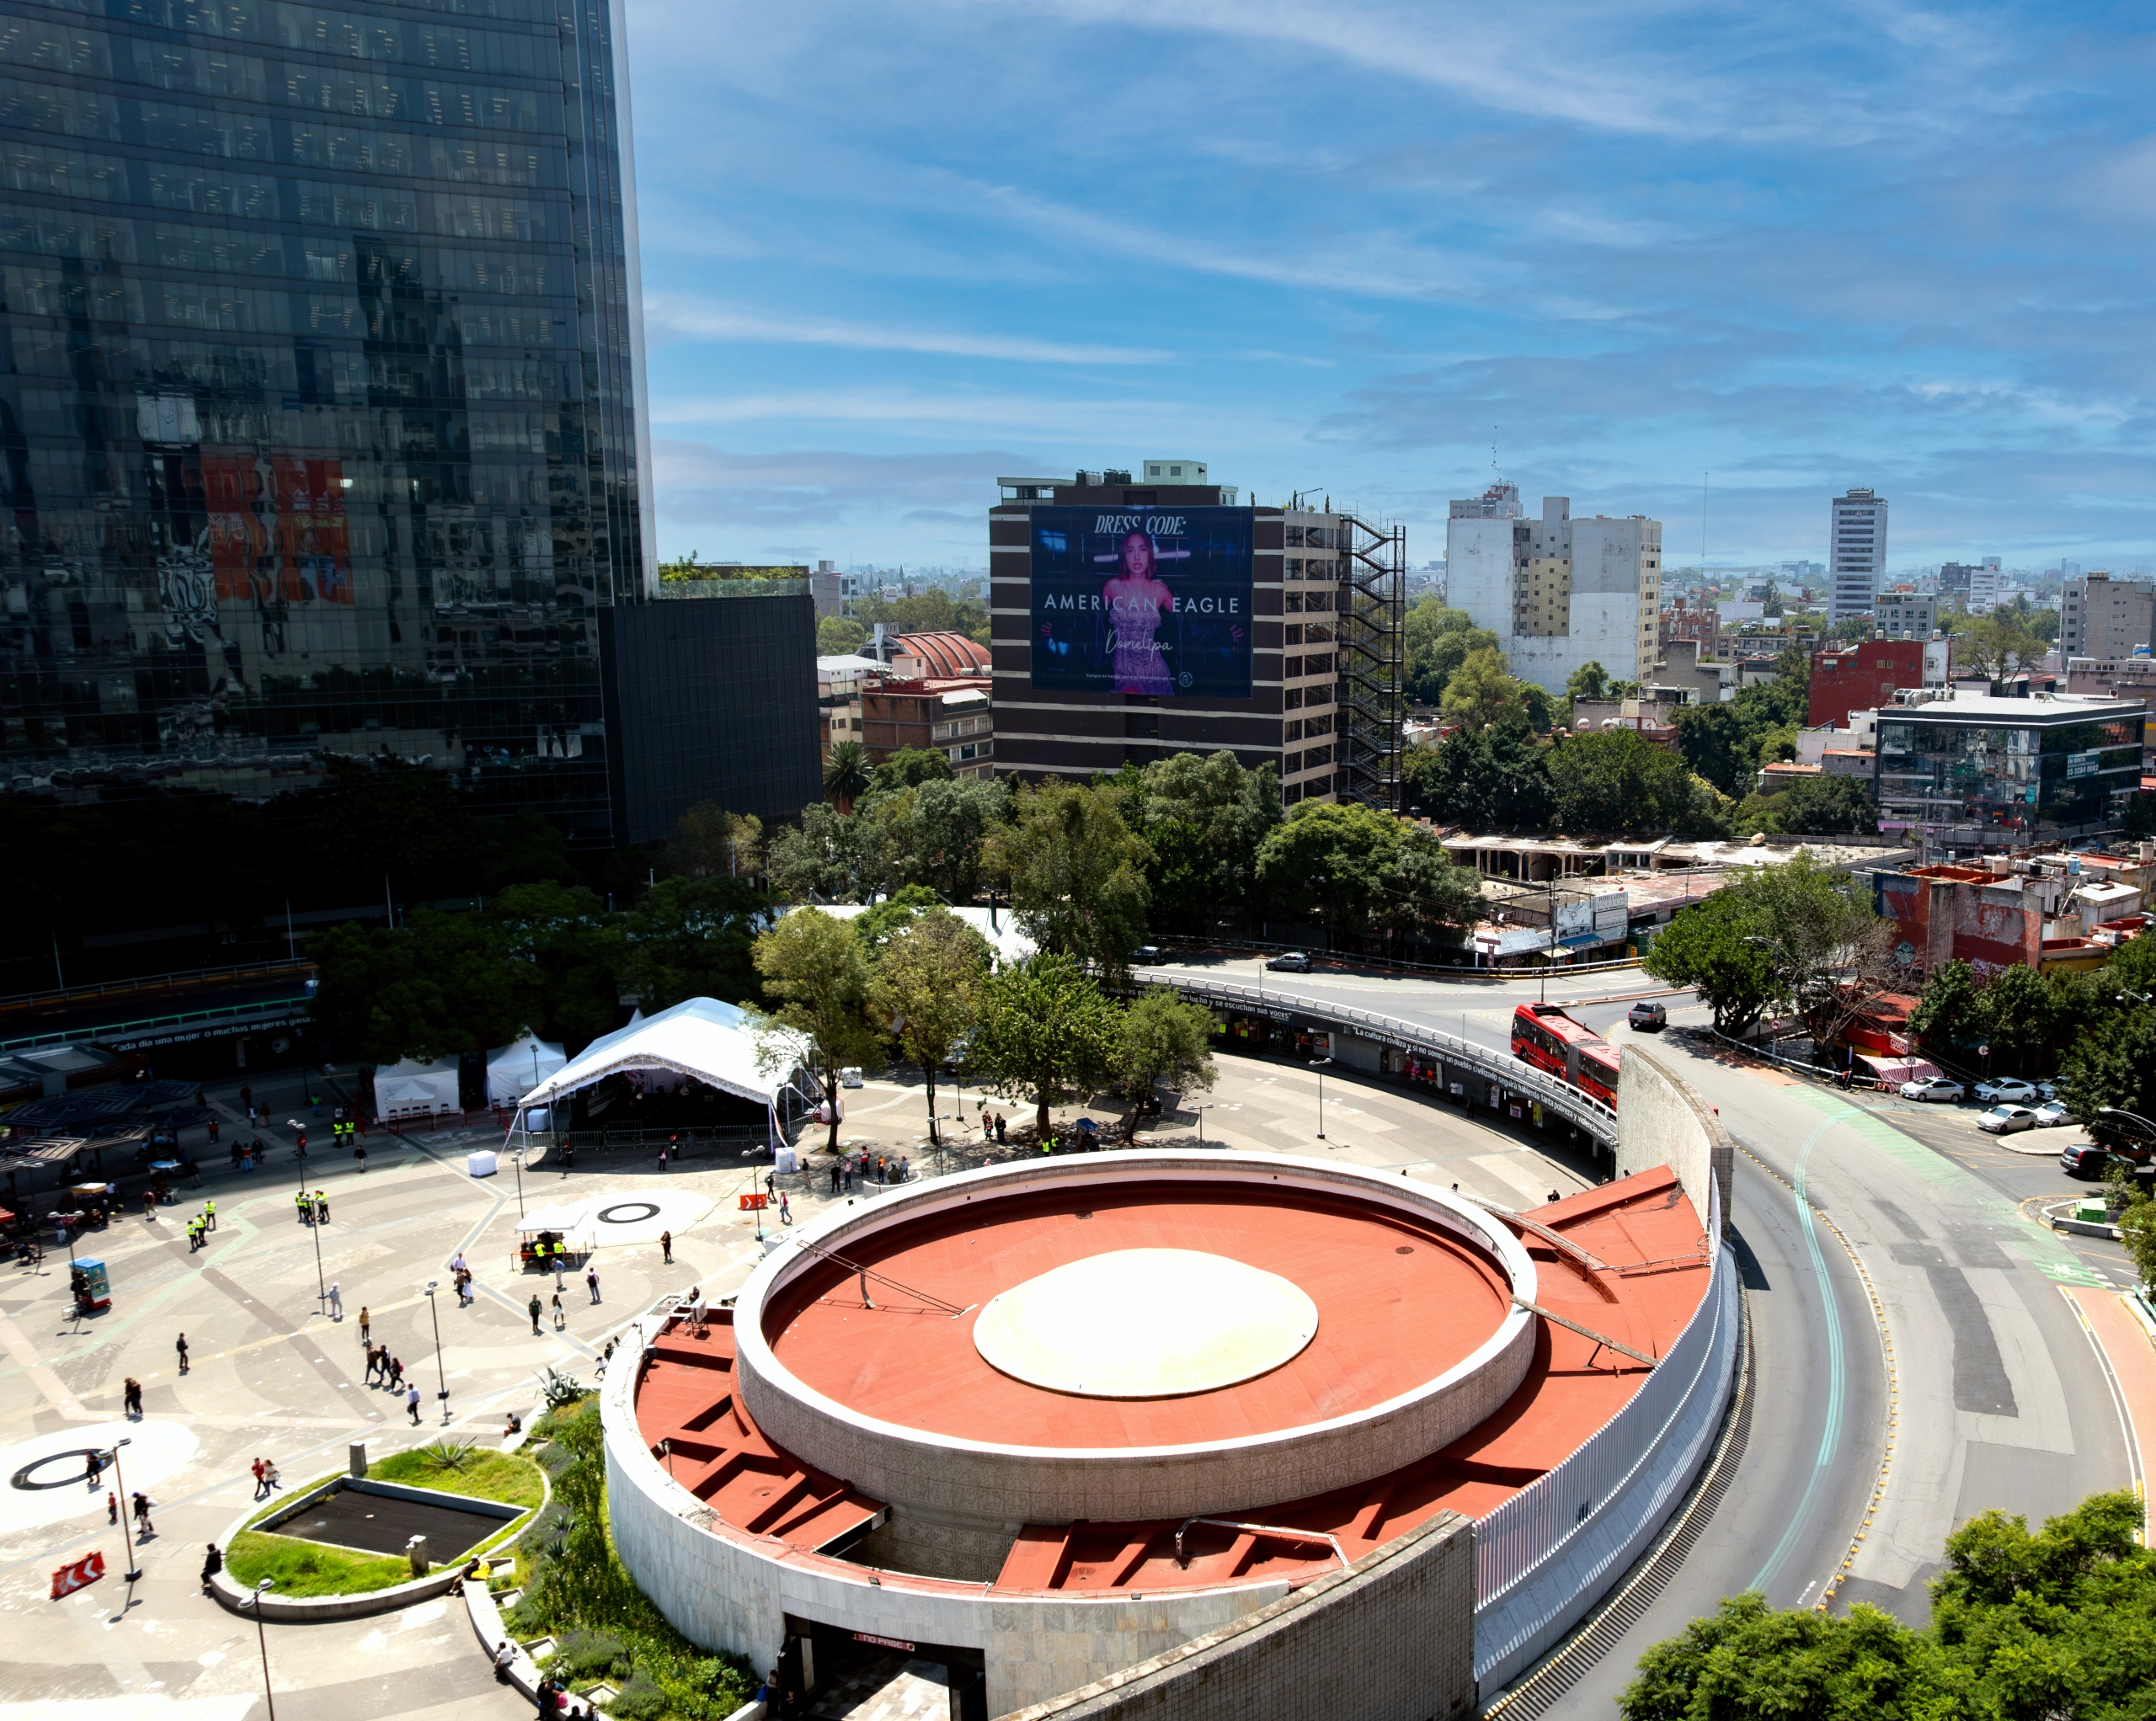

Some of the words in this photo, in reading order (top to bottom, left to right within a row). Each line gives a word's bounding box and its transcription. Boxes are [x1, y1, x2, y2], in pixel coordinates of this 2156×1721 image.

[1094, 515, 1140, 534] DRESS
[1145, 516, 1187, 535] CODE:
[1044, 594, 1157, 612] AMERICAN
[1172, 597, 1238, 613] EAGLE
[1106, 629, 1172, 661] Domelipa
[1597, 898, 1627, 908] FOTOS
[1610, 892, 1626, 901] LATINO
[1189, 995, 1208, 1004] lucha
[1225, 1001, 1256, 1013] escuchan
[174, 1032, 202, 1043] mujer
[213, 1026, 248, 1036] muchas
[250, 1018, 287, 1031] mujeres
[1890, 1039, 1905, 1052] OXXO
[1365, 1031, 1386, 1042] cultura
[1387, 1036, 1406, 1047] civiliza
[1428, 1049, 1445, 1060] somos
[1454, 1058, 1472, 1071] pueblo
[1473, 1064, 1497, 1081] civilizado
[1518, 1084, 1540, 1100] habiendo
[1540, 1094, 1554, 1106] tanta
[1554, 1101, 1573, 1117] pobreza
[1573, 1112, 1577, 1122] y
[1577, 1115, 1598, 1133] violencia
[863, 1634, 876, 1644] NO
[878, 1638, 903, 1649] PASE
